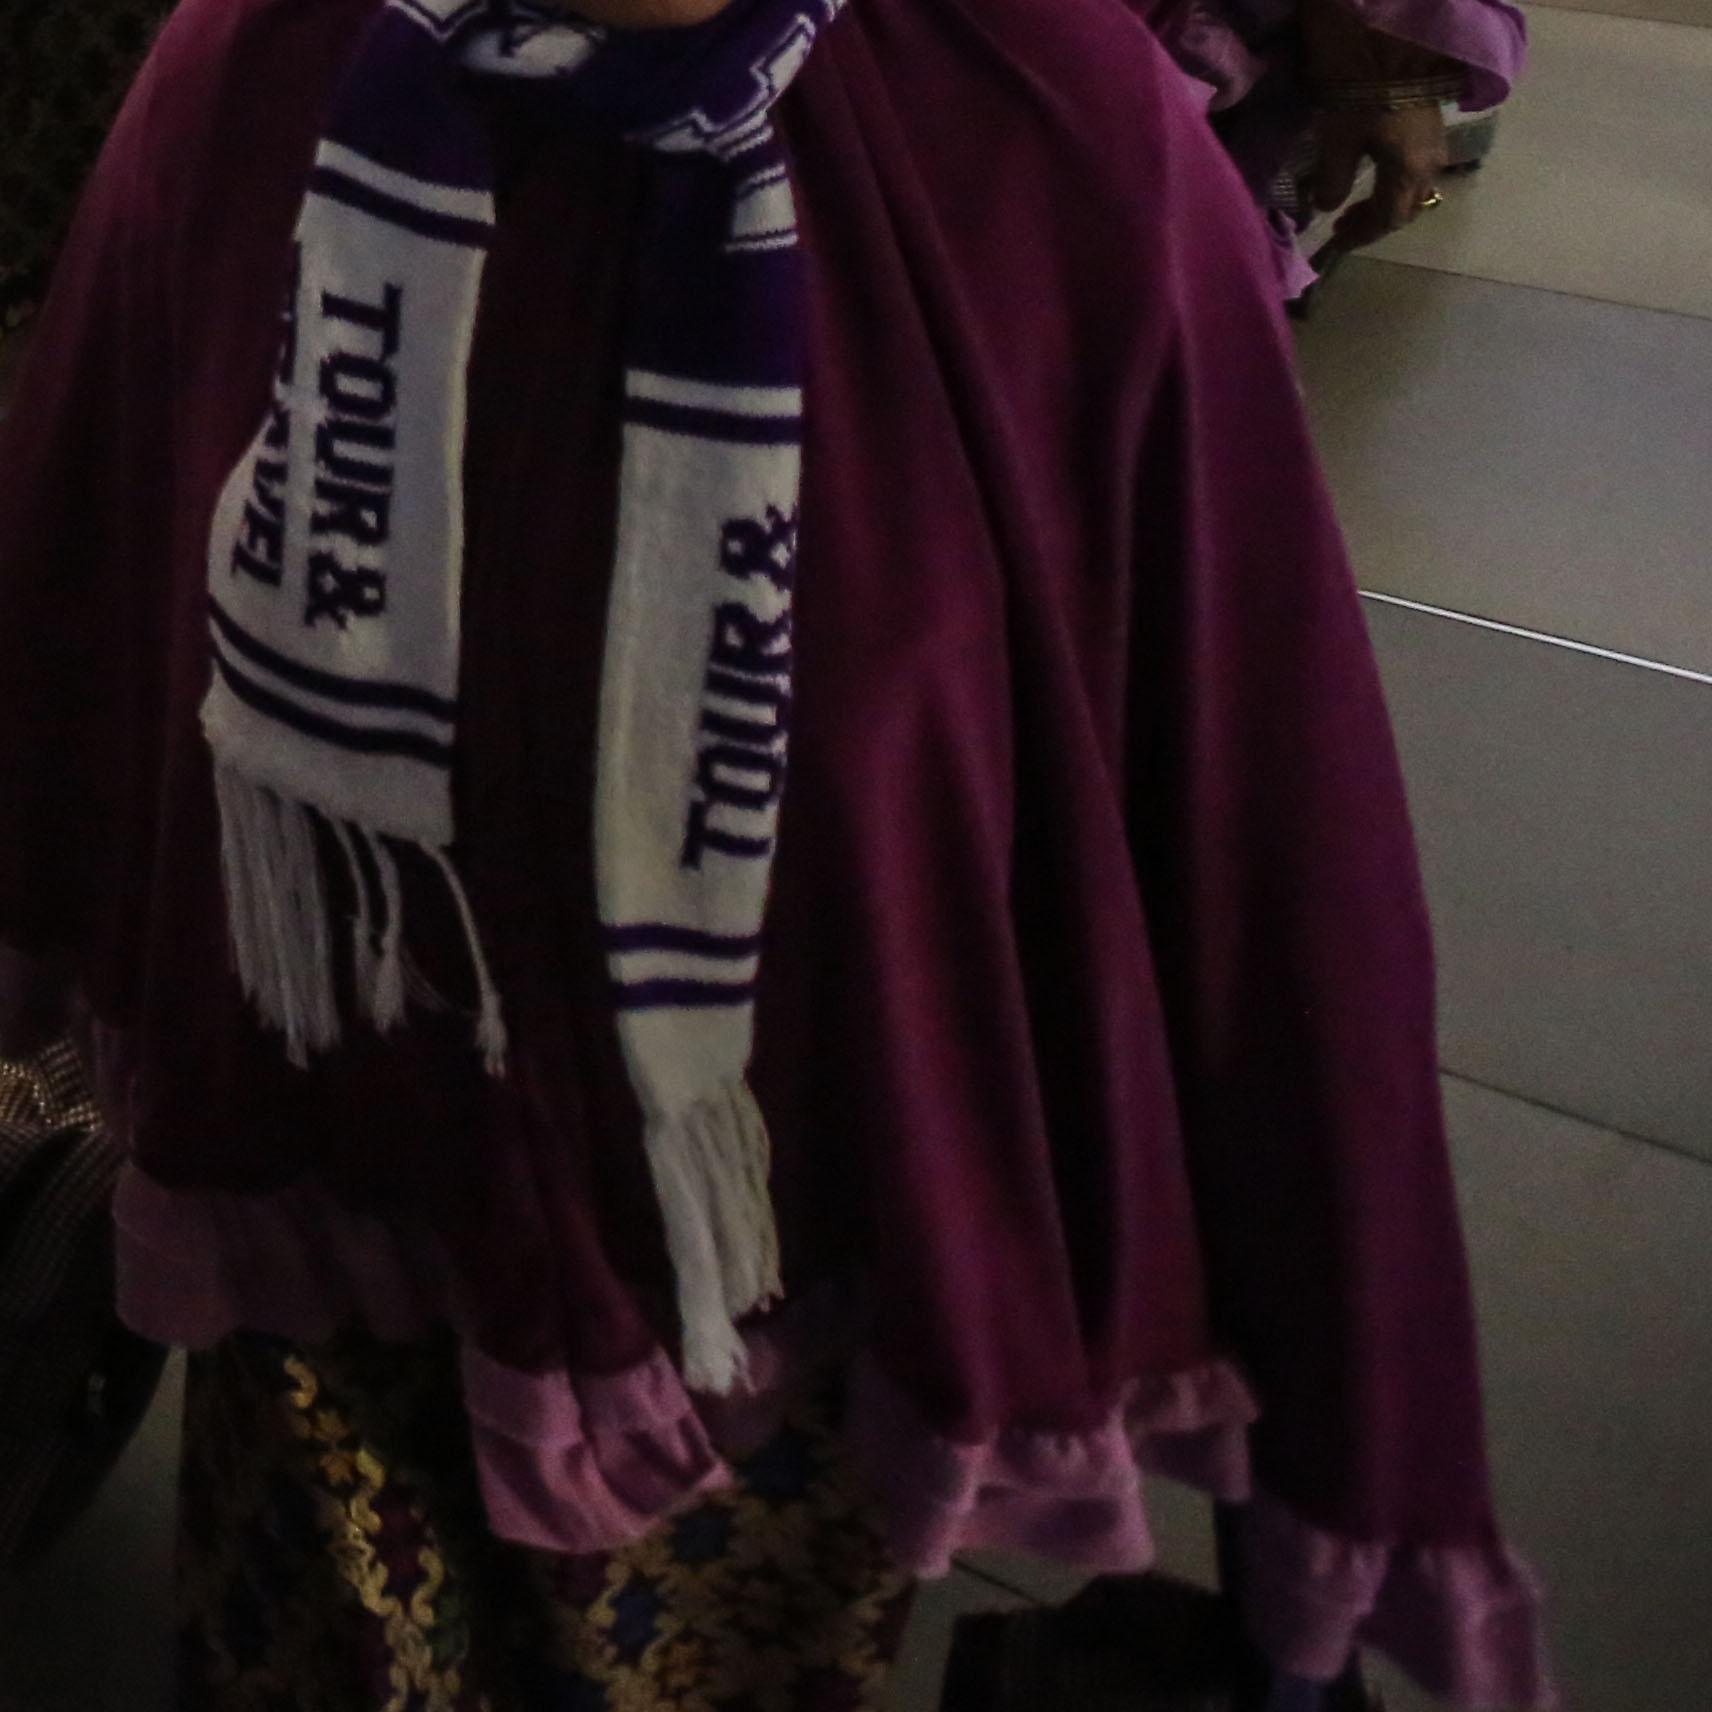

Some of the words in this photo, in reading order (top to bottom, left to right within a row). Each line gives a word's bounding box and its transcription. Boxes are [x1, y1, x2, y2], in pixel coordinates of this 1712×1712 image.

[311, 282, 402, 548] TOUR
[303, 547, 389, 633] &
[680, 598, 792, 871] TOUR
